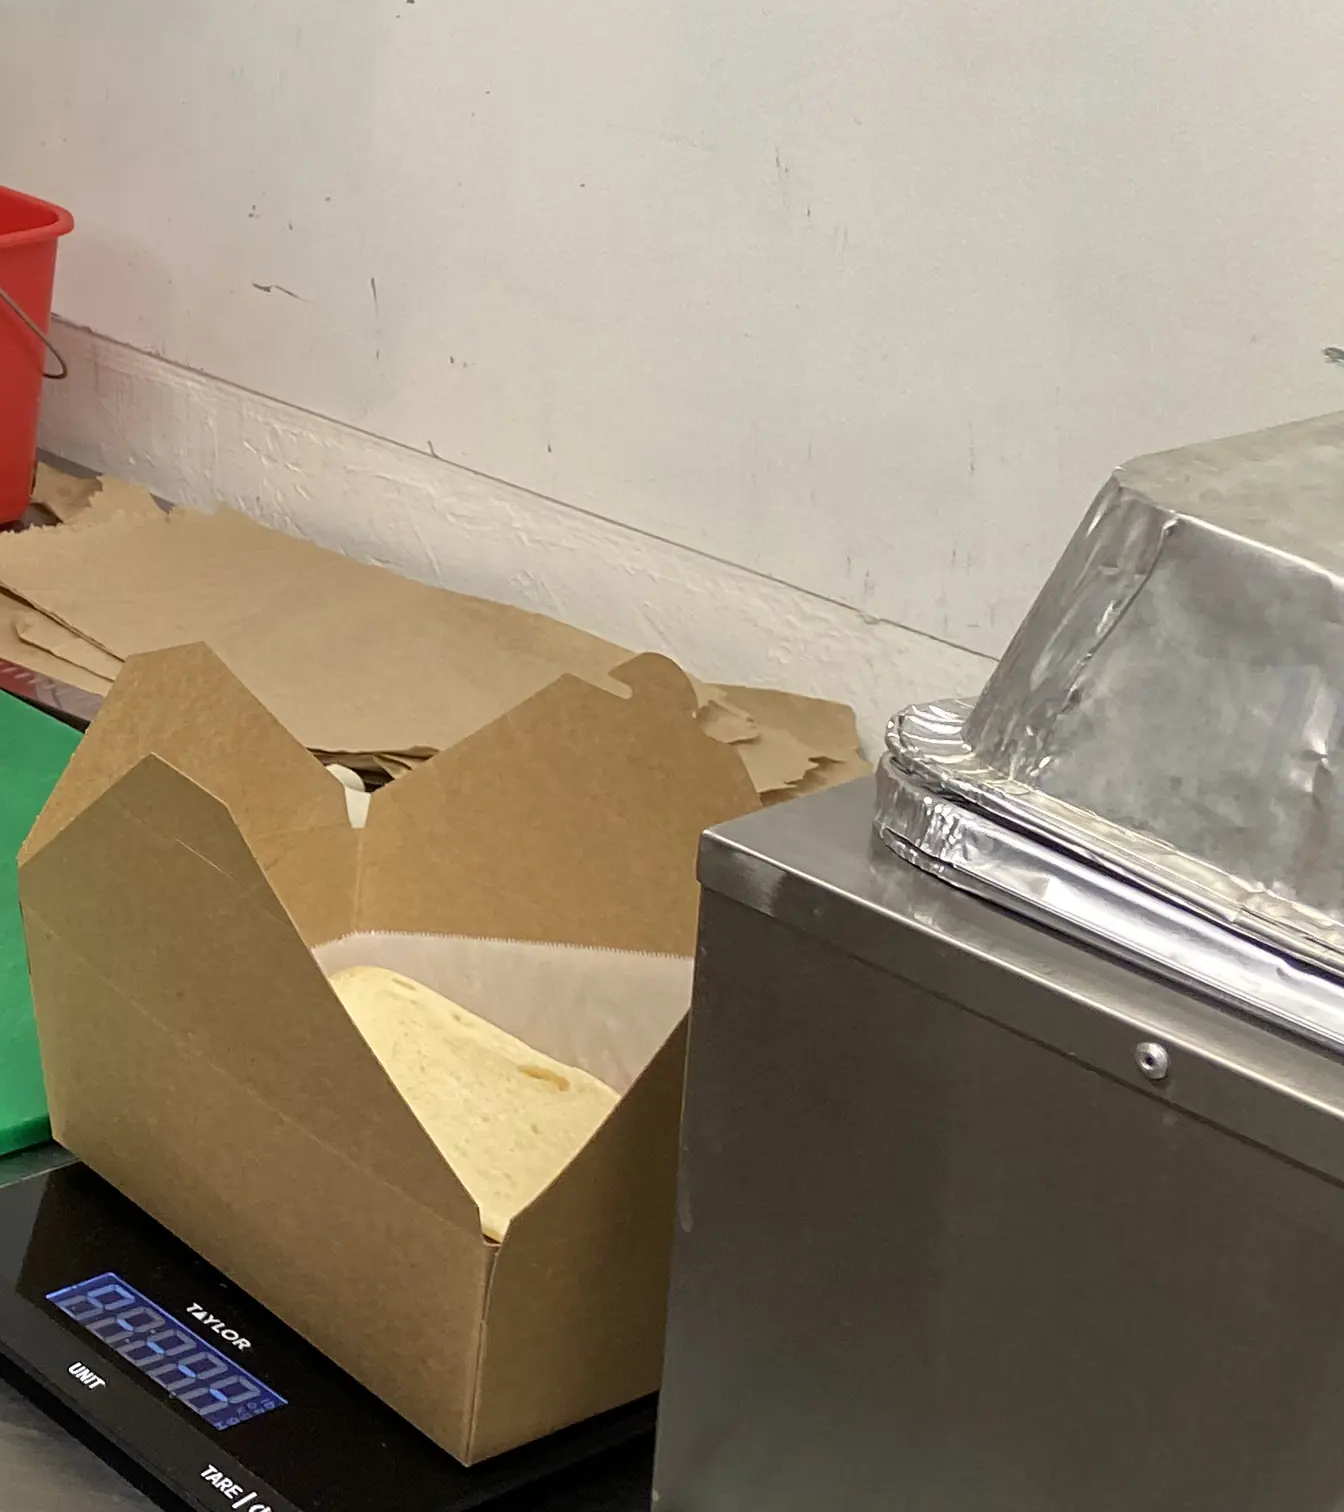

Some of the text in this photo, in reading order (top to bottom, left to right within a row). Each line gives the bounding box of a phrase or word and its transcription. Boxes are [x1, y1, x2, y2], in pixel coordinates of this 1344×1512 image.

[185, 1302, 253, 1352] TAYLOR
[67, 1361, 107, 1390] UNIT
[200, 1463, 244, 1500] TARE
